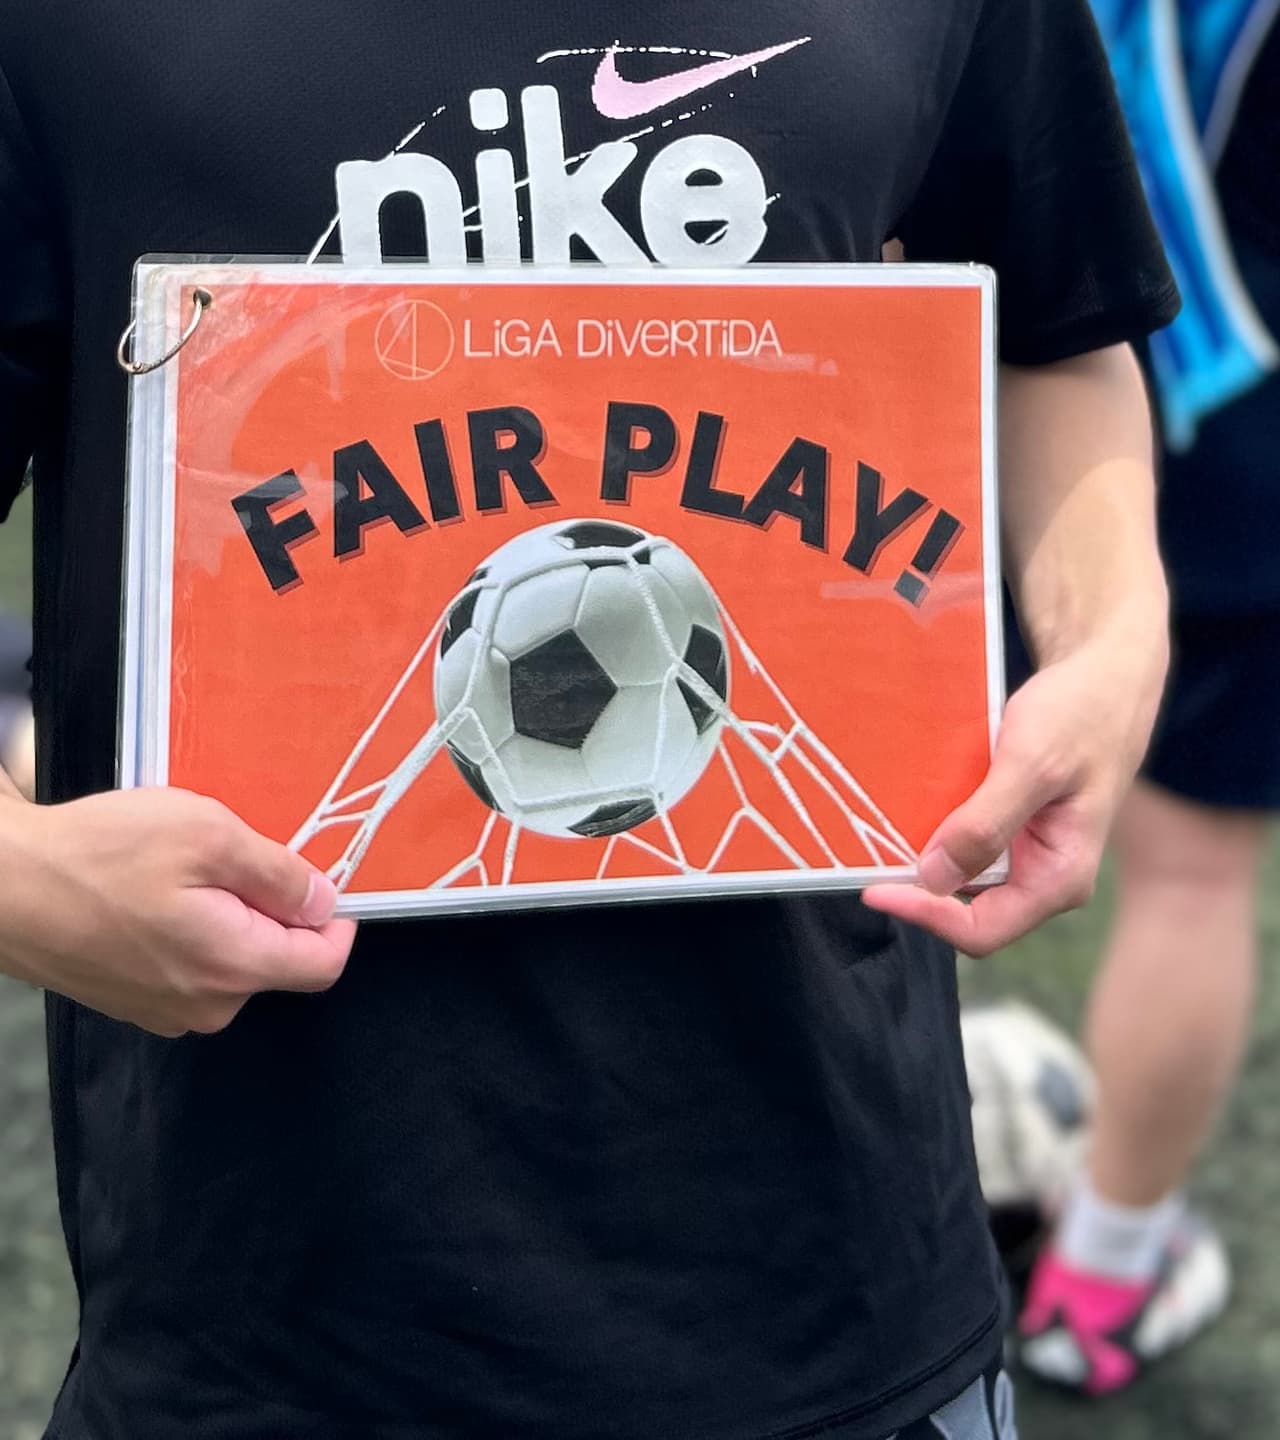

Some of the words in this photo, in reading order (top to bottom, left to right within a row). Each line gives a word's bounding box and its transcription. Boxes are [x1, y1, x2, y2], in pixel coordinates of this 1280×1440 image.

[335, 85, 768, 264] nike
[231, 405, 559, 594] FAIR
[599, 401, 964, 608] PLAY!
